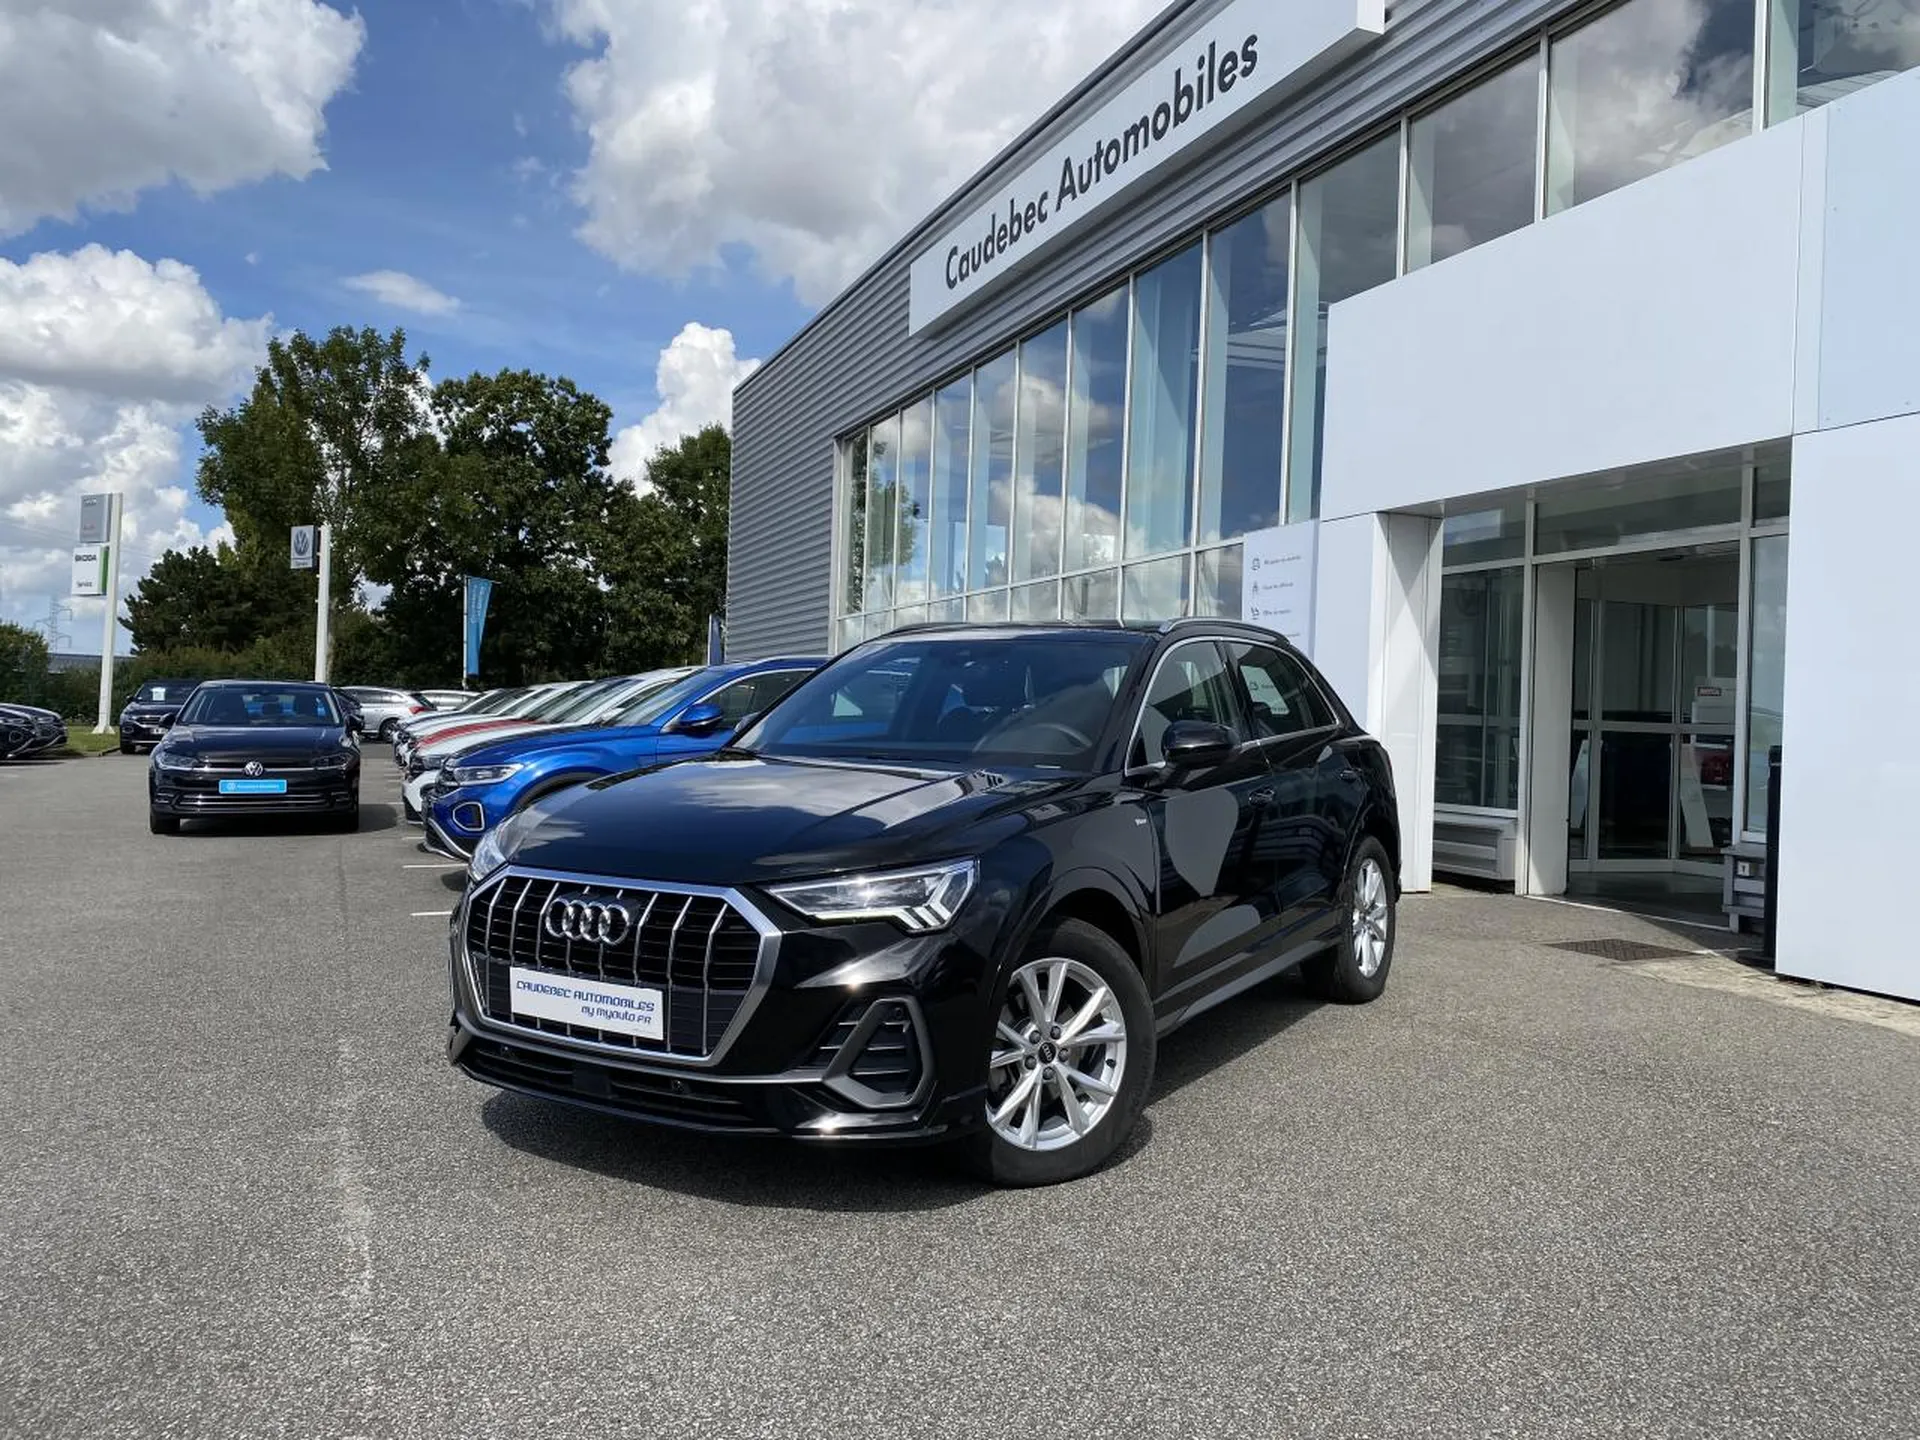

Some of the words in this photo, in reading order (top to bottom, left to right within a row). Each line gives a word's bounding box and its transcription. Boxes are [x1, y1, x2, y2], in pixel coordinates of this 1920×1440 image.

[945, 190, 1049, 290] Caudebec
[1055, 33, 1259, 212] Automobiles
[516, 980, 571, 998] CAUDEBEC
[573, 990, 655, 1012] AUTOMOBILES
